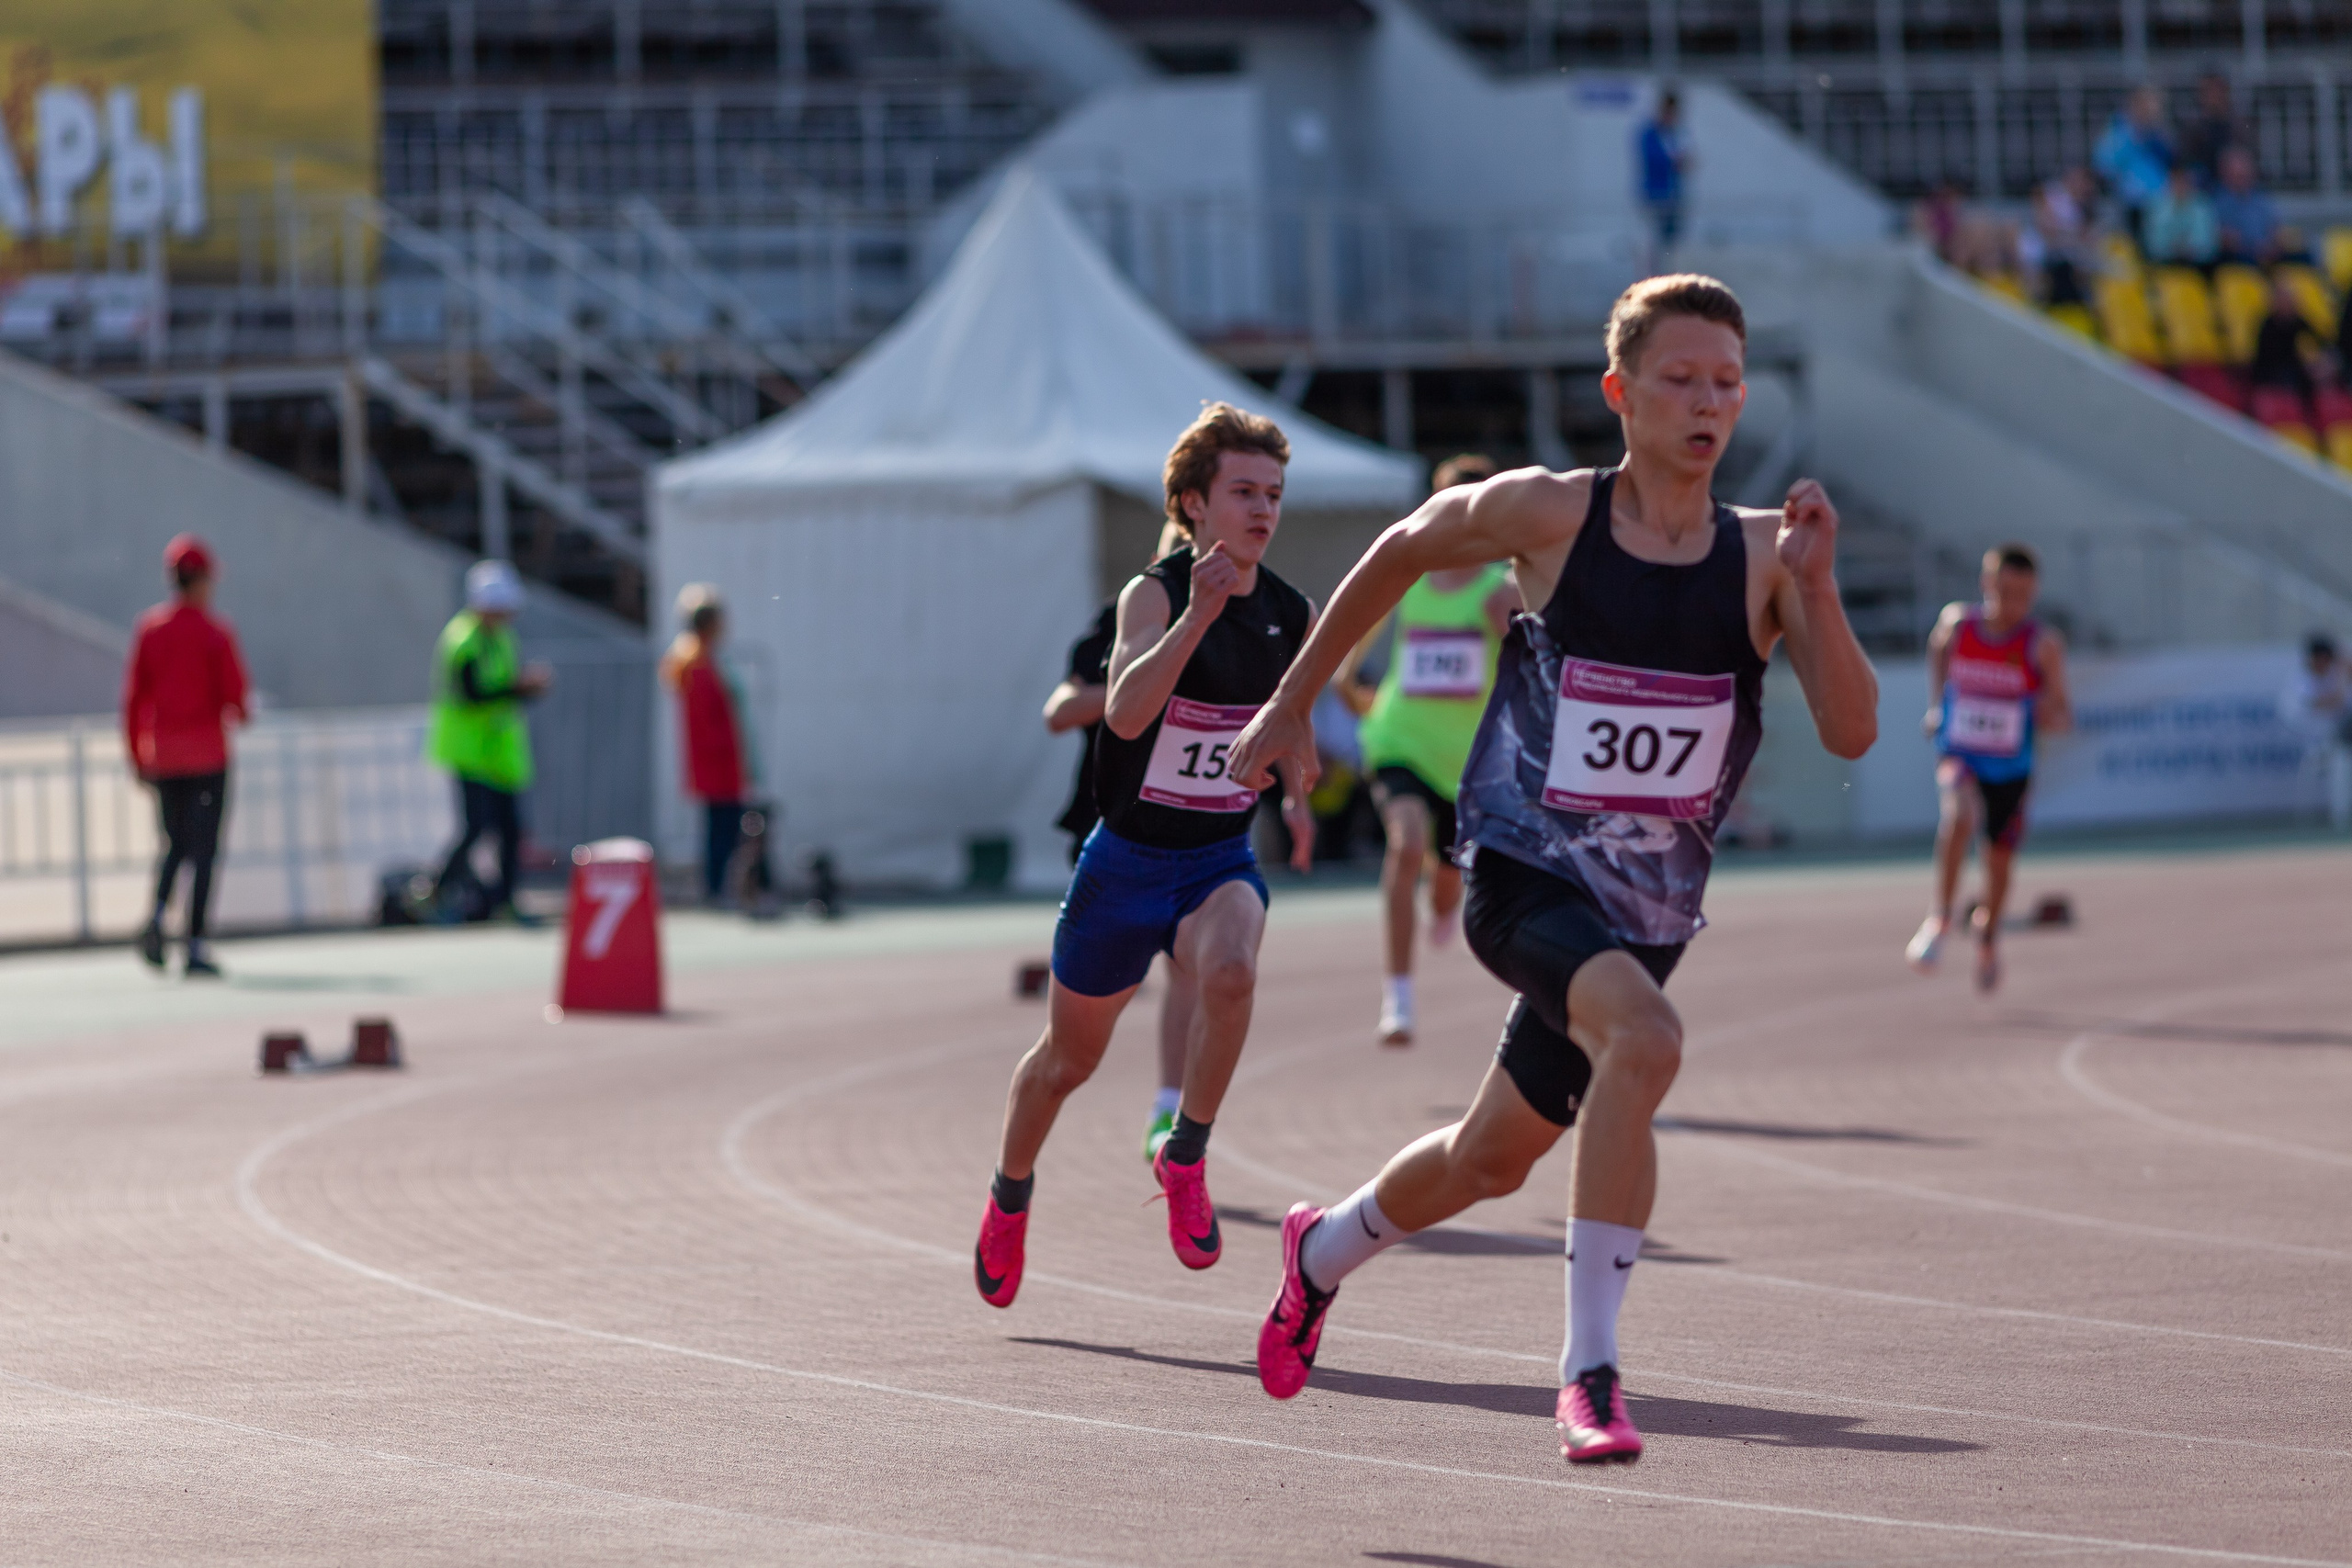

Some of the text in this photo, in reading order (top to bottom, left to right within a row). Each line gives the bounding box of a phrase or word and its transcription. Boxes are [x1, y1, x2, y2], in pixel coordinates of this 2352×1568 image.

[1177, 741, 1233, 781] 15
[1583, 718, 1702, 777] 307
[583, 879, 640, 959] 7
